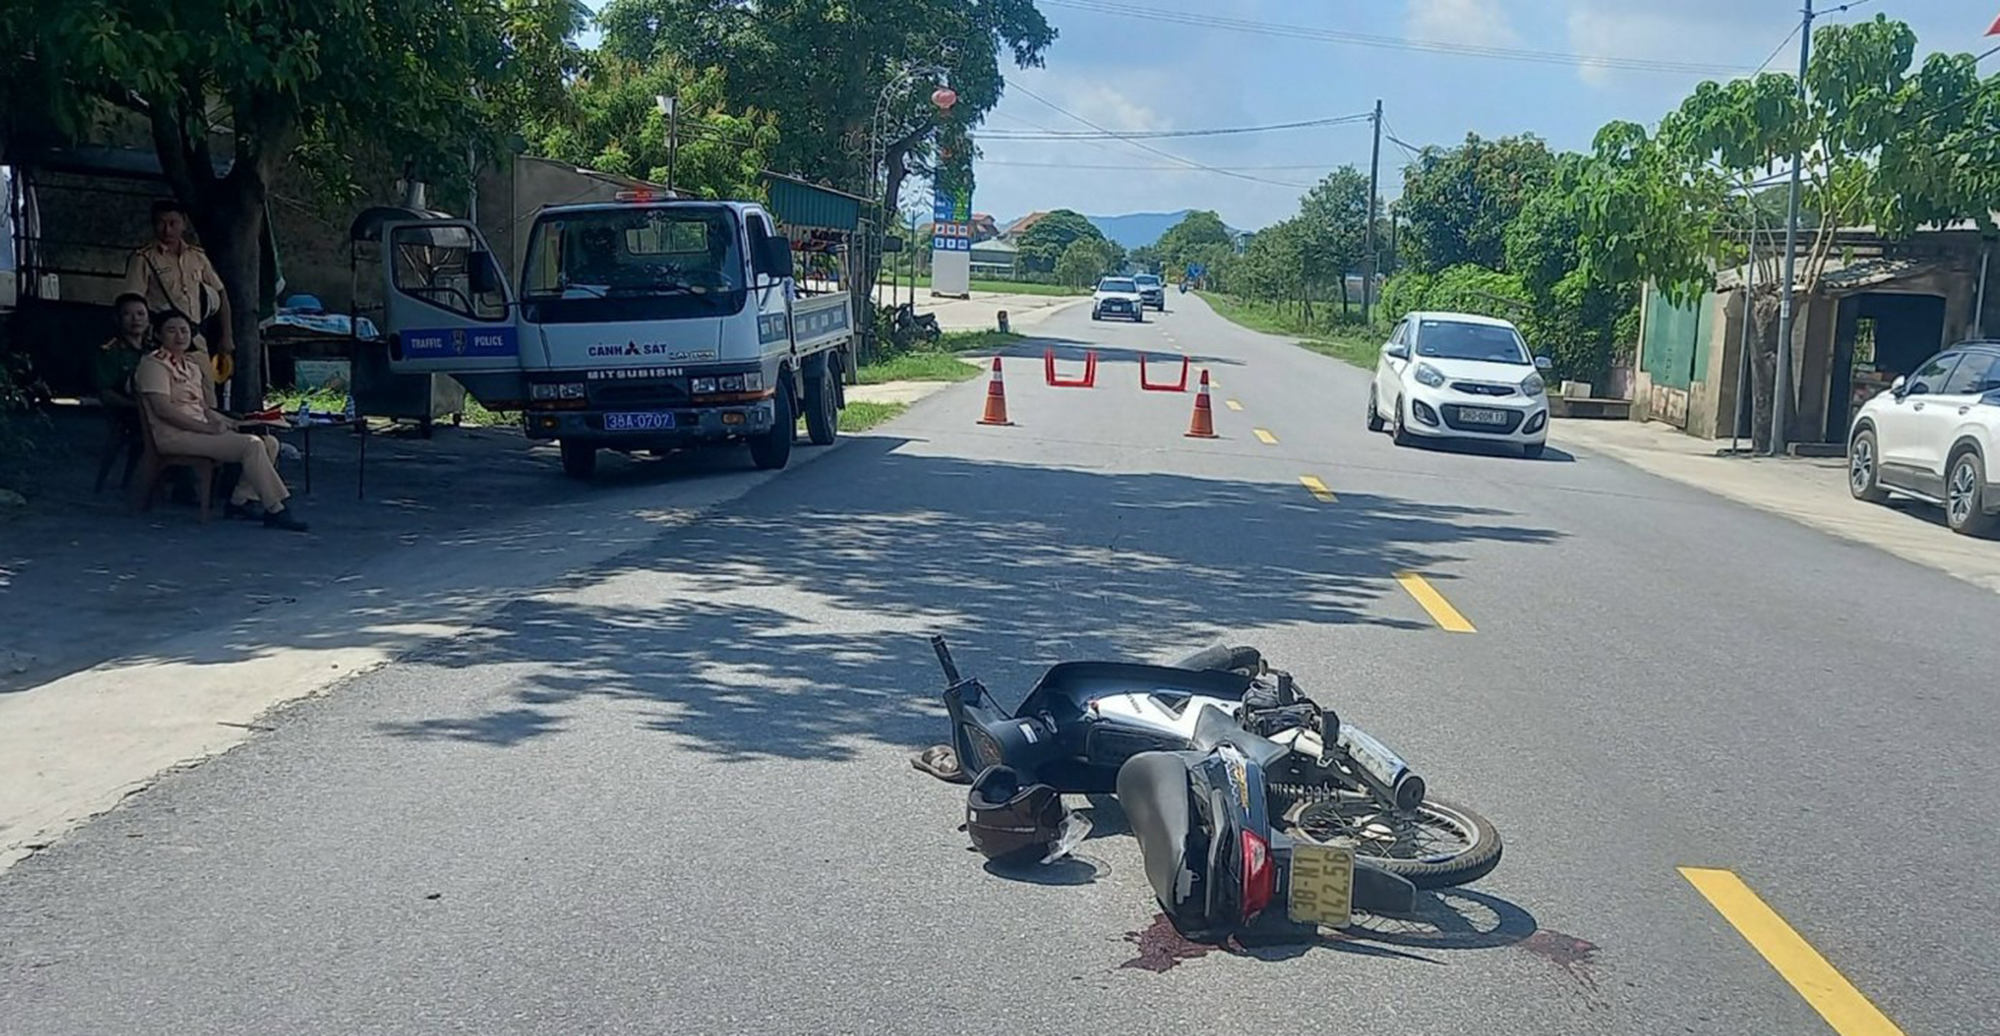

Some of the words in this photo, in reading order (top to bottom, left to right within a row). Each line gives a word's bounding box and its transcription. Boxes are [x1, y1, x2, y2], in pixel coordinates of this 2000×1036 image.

[411, 337, 443, 349] TRAFFIC
[474, 335, 504, 347] POLICE
[587, 368, 684, 380] MITSUBISHI
